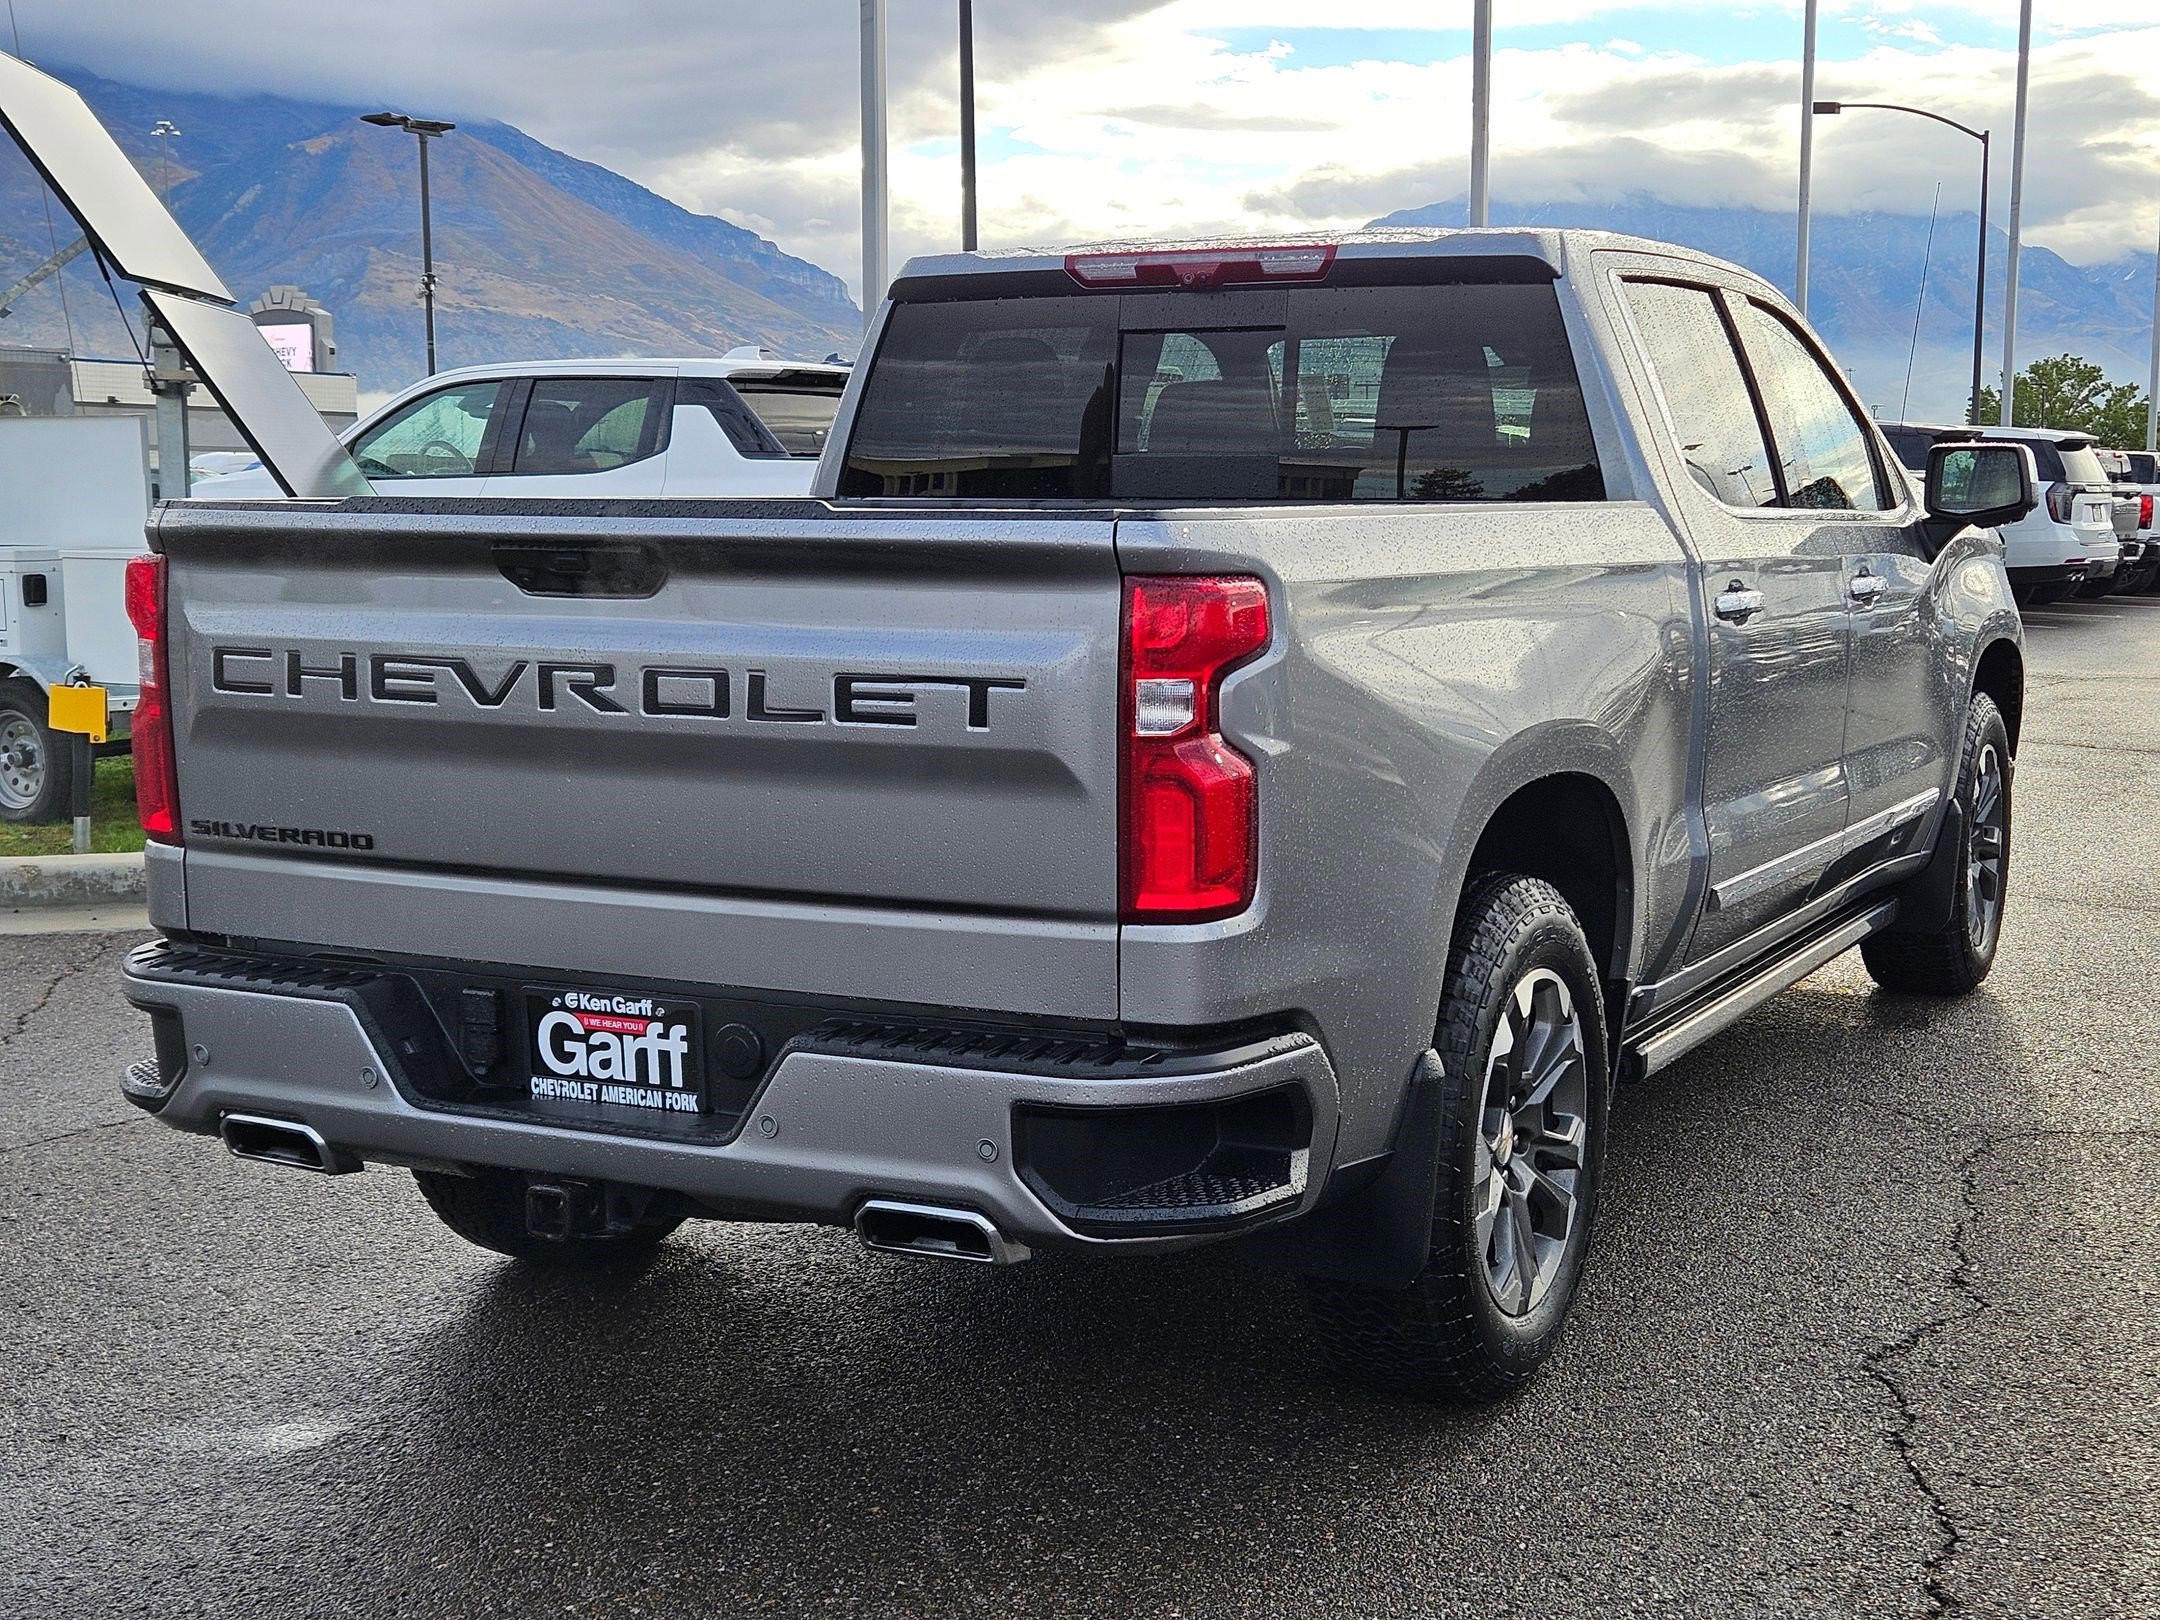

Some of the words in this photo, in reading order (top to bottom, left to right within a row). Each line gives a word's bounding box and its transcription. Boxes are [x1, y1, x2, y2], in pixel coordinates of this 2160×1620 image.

[272, 346, 297, 357] HEVY
[211, 645, 1027, 733] CHEVROLET
[190, 819, 374, 850] SILVERADO
[579, 993, 611, 1013] Ken
[612, 996, 653, 1016] Garff
[589, 1018, 602, 1027] WE
[602, 1019, 622, 1029] HEAR
[623, 1021, 638, 1031] YOU
[537, 1010, 688, 1088] Garff
[530, 1076, 599, 1101] CHEVROLET
[601, 1085, 663, 1109] AMERICAN
[665, 1091, 699, 1112] FORK
